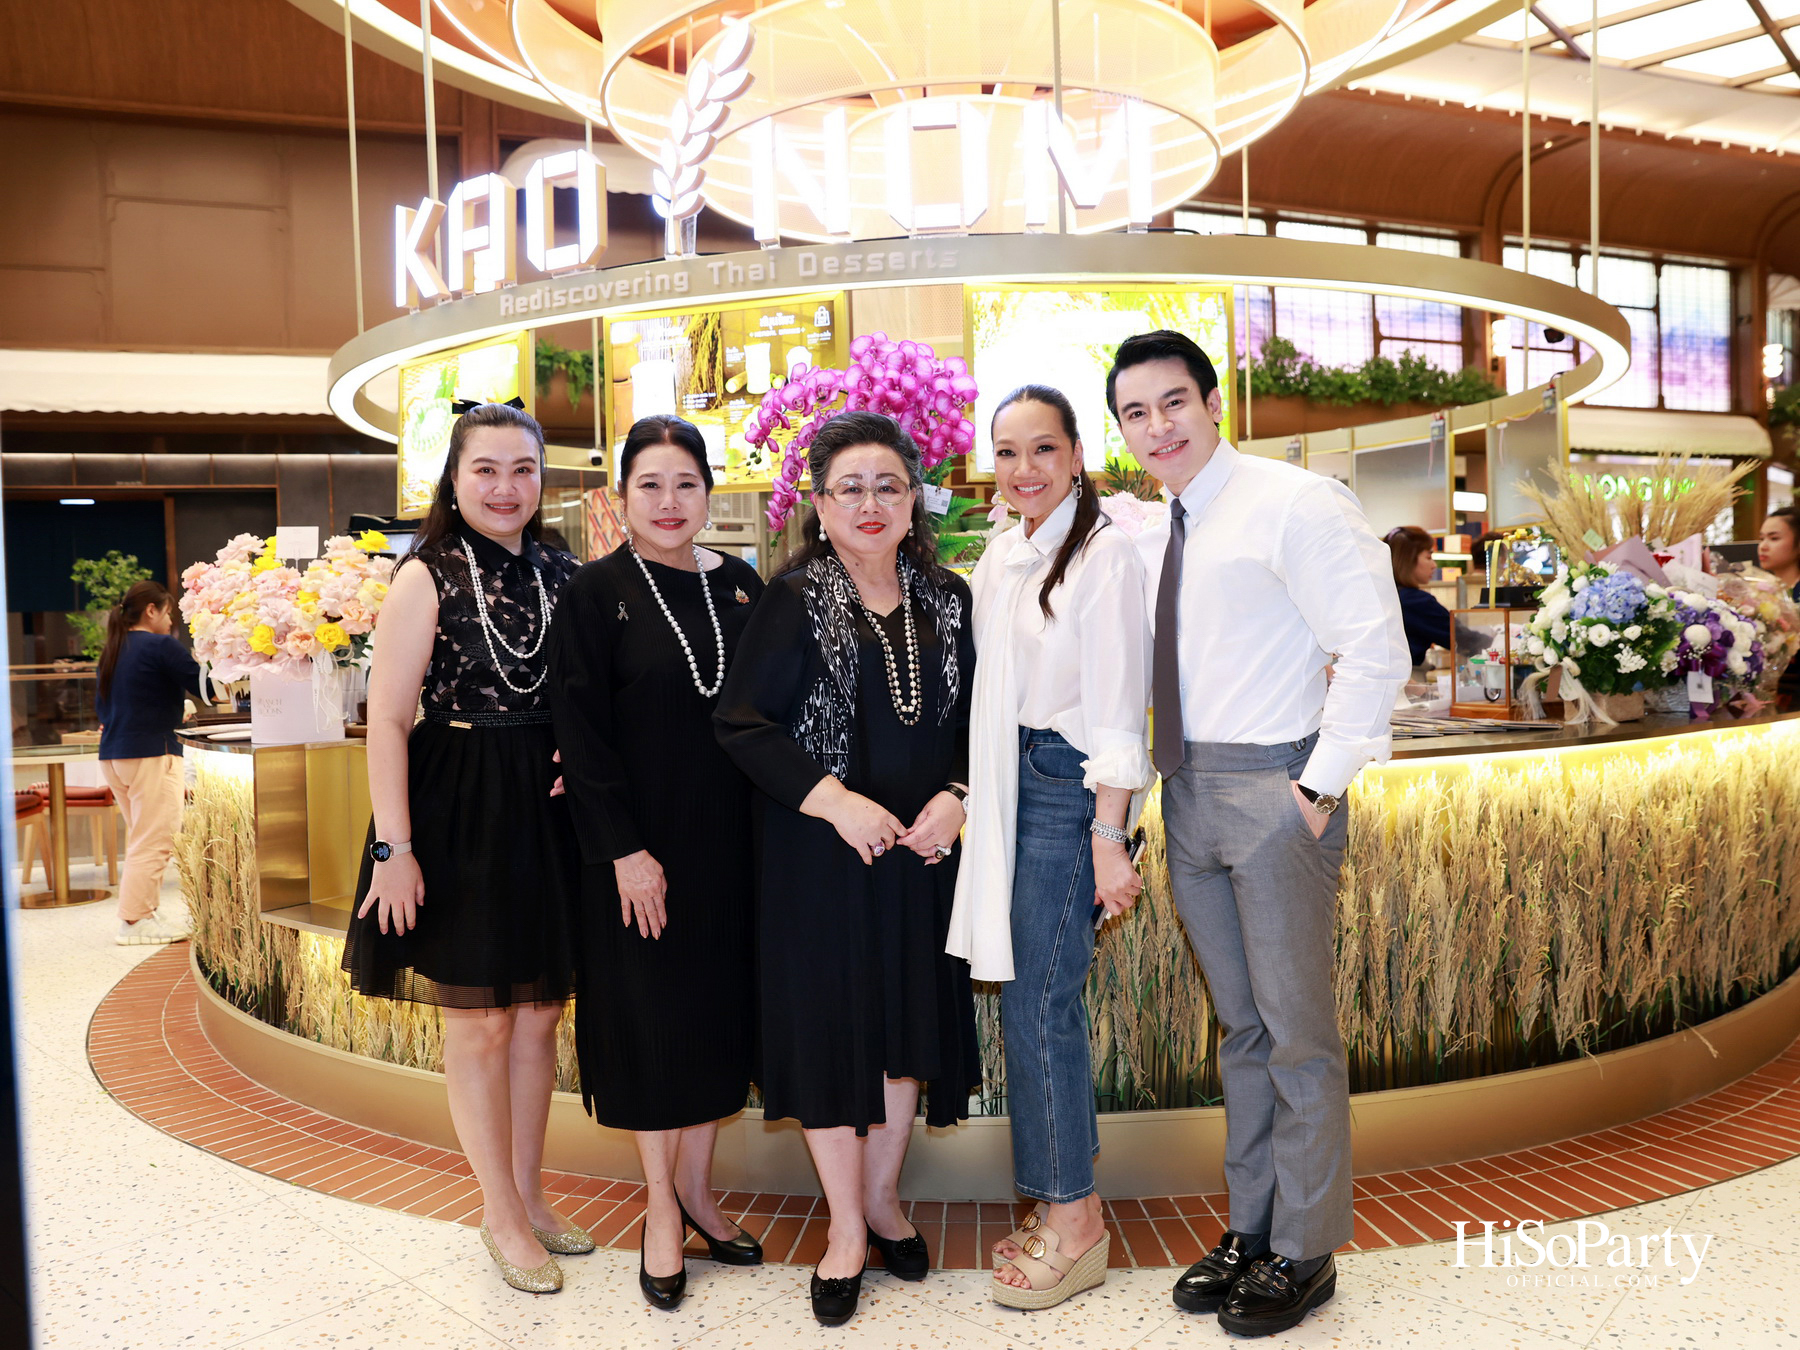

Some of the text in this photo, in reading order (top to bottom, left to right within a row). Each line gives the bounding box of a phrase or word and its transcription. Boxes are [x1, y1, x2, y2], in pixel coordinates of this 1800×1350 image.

[394, 97, 1155, 310] KAO NOM
[499, 248, 959, 317] Rediscovering Thai Desserts
